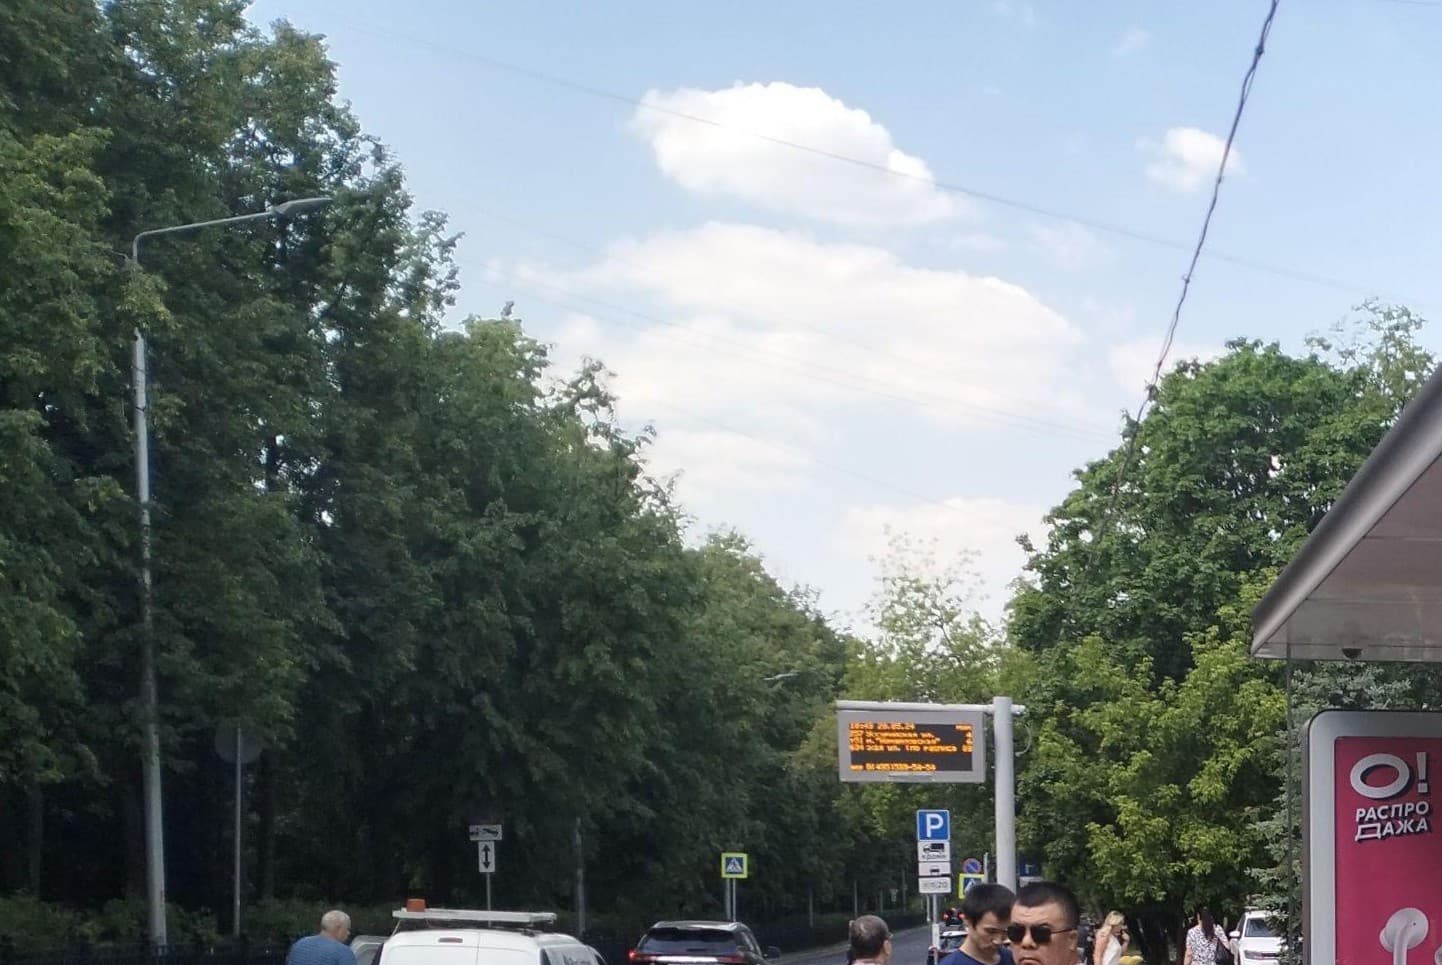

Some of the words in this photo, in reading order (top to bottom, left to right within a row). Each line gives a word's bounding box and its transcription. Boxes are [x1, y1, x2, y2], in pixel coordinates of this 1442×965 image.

[1355, 800, 1429, 822] РАСПРО
[926, 813, 944, 838] P
[1354, 817, 1428, 841] ДАЖА
